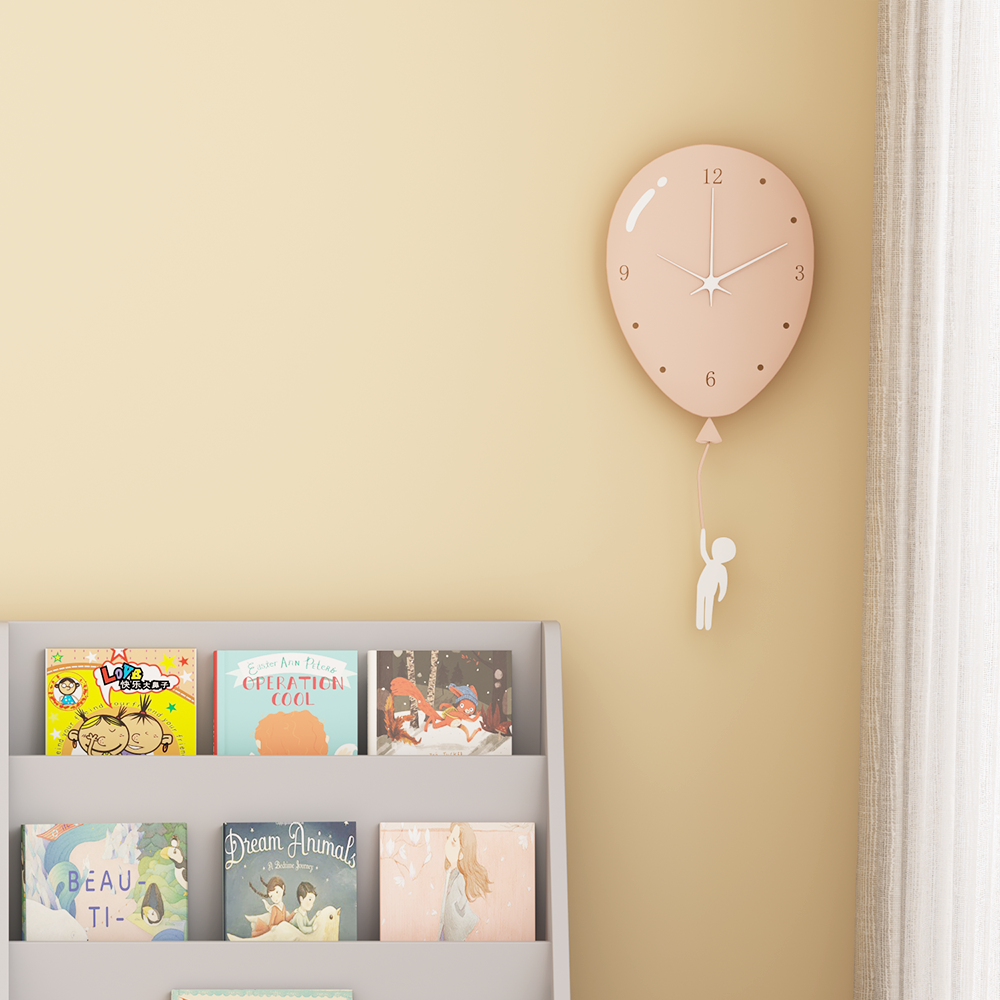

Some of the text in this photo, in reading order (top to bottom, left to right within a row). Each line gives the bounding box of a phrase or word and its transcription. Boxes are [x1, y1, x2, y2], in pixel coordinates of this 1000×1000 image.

[703, 168, 723, 184] 12
[619, 265, 630, 281] 9
[795, 265, 804, 281] 3
[706, 371, 716, 387] 6
[243, 676, 344, 690] OPERATION
[272, 692, 315, 706] COOL
[225, 822, 356, 870] Dream Animals
[68, 870, 146, 892] BEAU-
[88, 906, 124, 927] TI-
